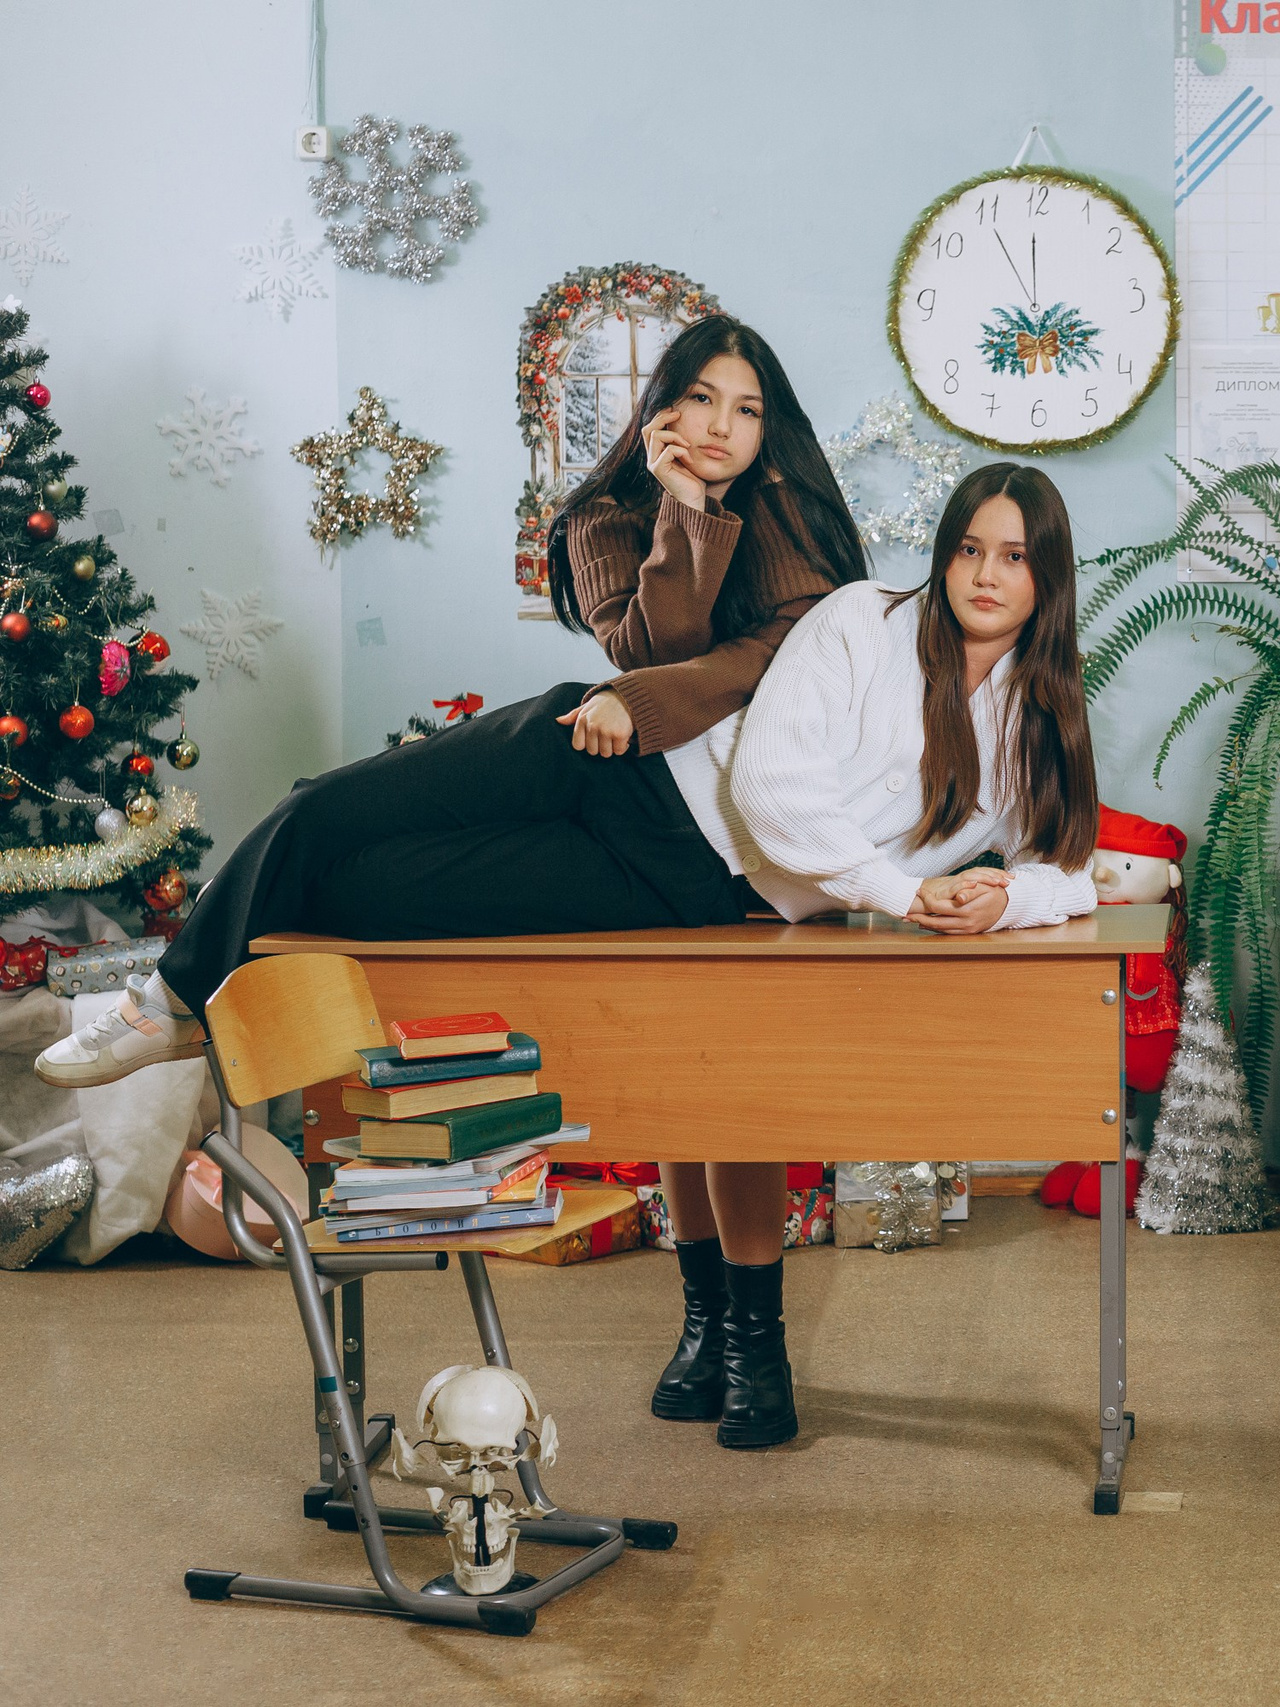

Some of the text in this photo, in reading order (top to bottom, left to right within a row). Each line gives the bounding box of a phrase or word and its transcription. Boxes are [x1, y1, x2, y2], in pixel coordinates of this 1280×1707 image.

[975, 194, 999, 226] 11
[1027, 186, 1049, 217] 12
[1081, 198, 1090, 225] 1
[931, 232, 964, 260] 10
[1106, 226, 1123, 255] 2
[917, 288, 936, 322] 9
[1128, 278, 1146, 313] 3
[943, 359, 959, 395] 8
[1118, 353, 1133, 385] 4
[1216, 380, 1280, 392] ДИПЛОМ
[981, 393, 1001, 419] 7
[1031, 400, 1047, 428] 6
[1081, 387, 1098, 418] 5
[375, 1217, 479, 1236] БИОЛОГИЯ
